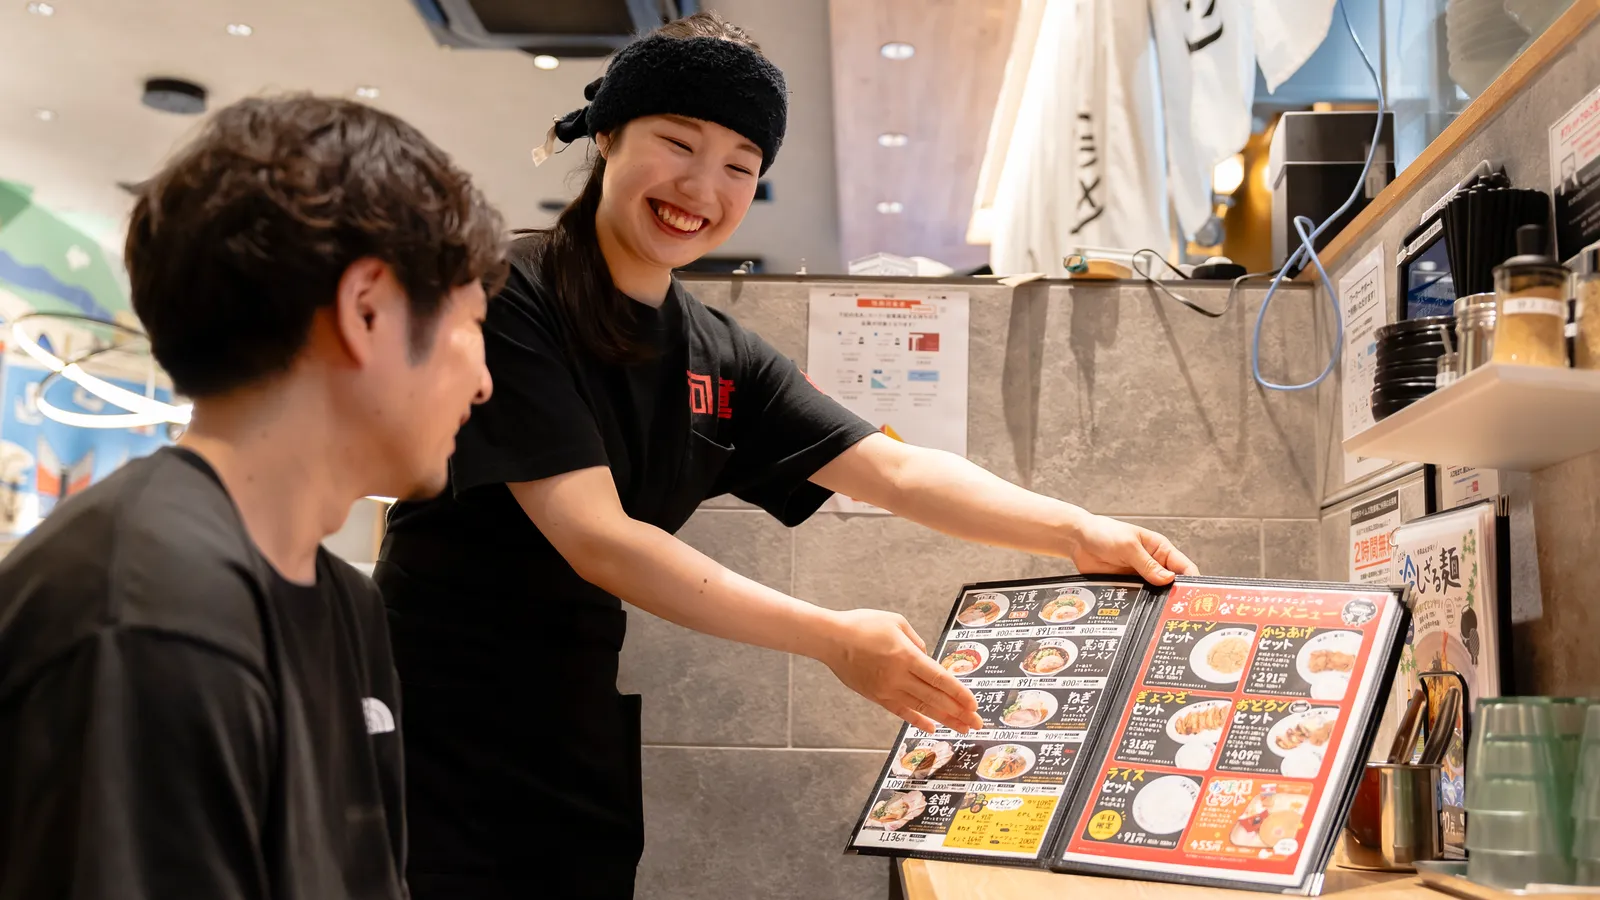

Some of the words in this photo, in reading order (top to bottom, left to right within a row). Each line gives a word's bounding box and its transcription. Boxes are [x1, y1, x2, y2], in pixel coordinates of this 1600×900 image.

[1399, 547, 1461, 595] 冷しざる麺
[1012, 590, 1038, 603] 河童
[1099, 588, 1128, 601] 河童
[1011, 602, 1039, 611] ラーメン
[1097, 601, 1130, 609] ラーメン
[1165, 620, 1218, 632] 半チャン
[1260, 626, 1317, 639] からあげ
[1162, 631, 1194, 643] セット
[1080, 638, 1118, 651] 黒河童
[1258, 638, 1293, 651] セット
[990, 652, 1020, 661] ラーメン
[1080, 651, 1113, 660] ラーメン
[1067, 690, 1095, 704] ねぎ
[1135, 690, 1193, 704] ぎょうざ
[978, 704, 1000, 712] ーメン
[1061, 705, 1094, 714] ラーメン
[1132, 703, 1164, 716] セット
[1233, 711, 1274, 725] セット
[1039, 744, 1065, 757] 野菜
[1038, 757, 1070, 766] ラーメン
[1106, 768, 1145, 782] ライス
[1102, 781, 1136, 793] セット
[928, 794, 951, 805] 全部
[1207, 793, 1246, 806] セット
